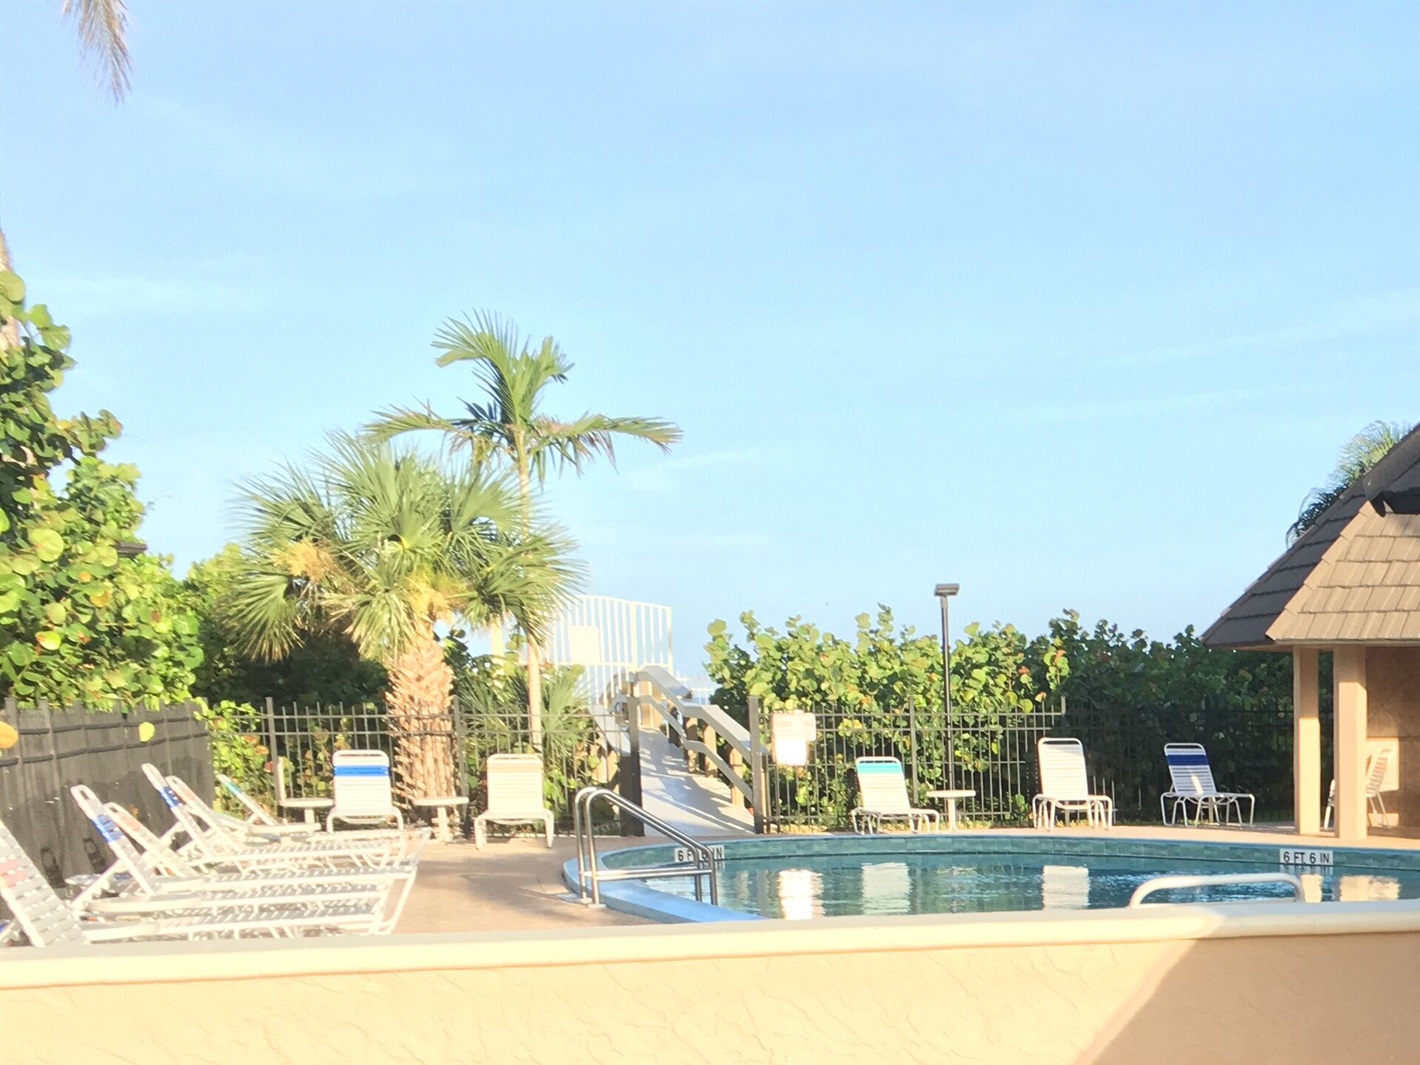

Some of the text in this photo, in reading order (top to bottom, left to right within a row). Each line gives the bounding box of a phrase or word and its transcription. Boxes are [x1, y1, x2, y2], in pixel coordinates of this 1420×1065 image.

[1283, 851, 1330, 864] 6 FT 6 IN
